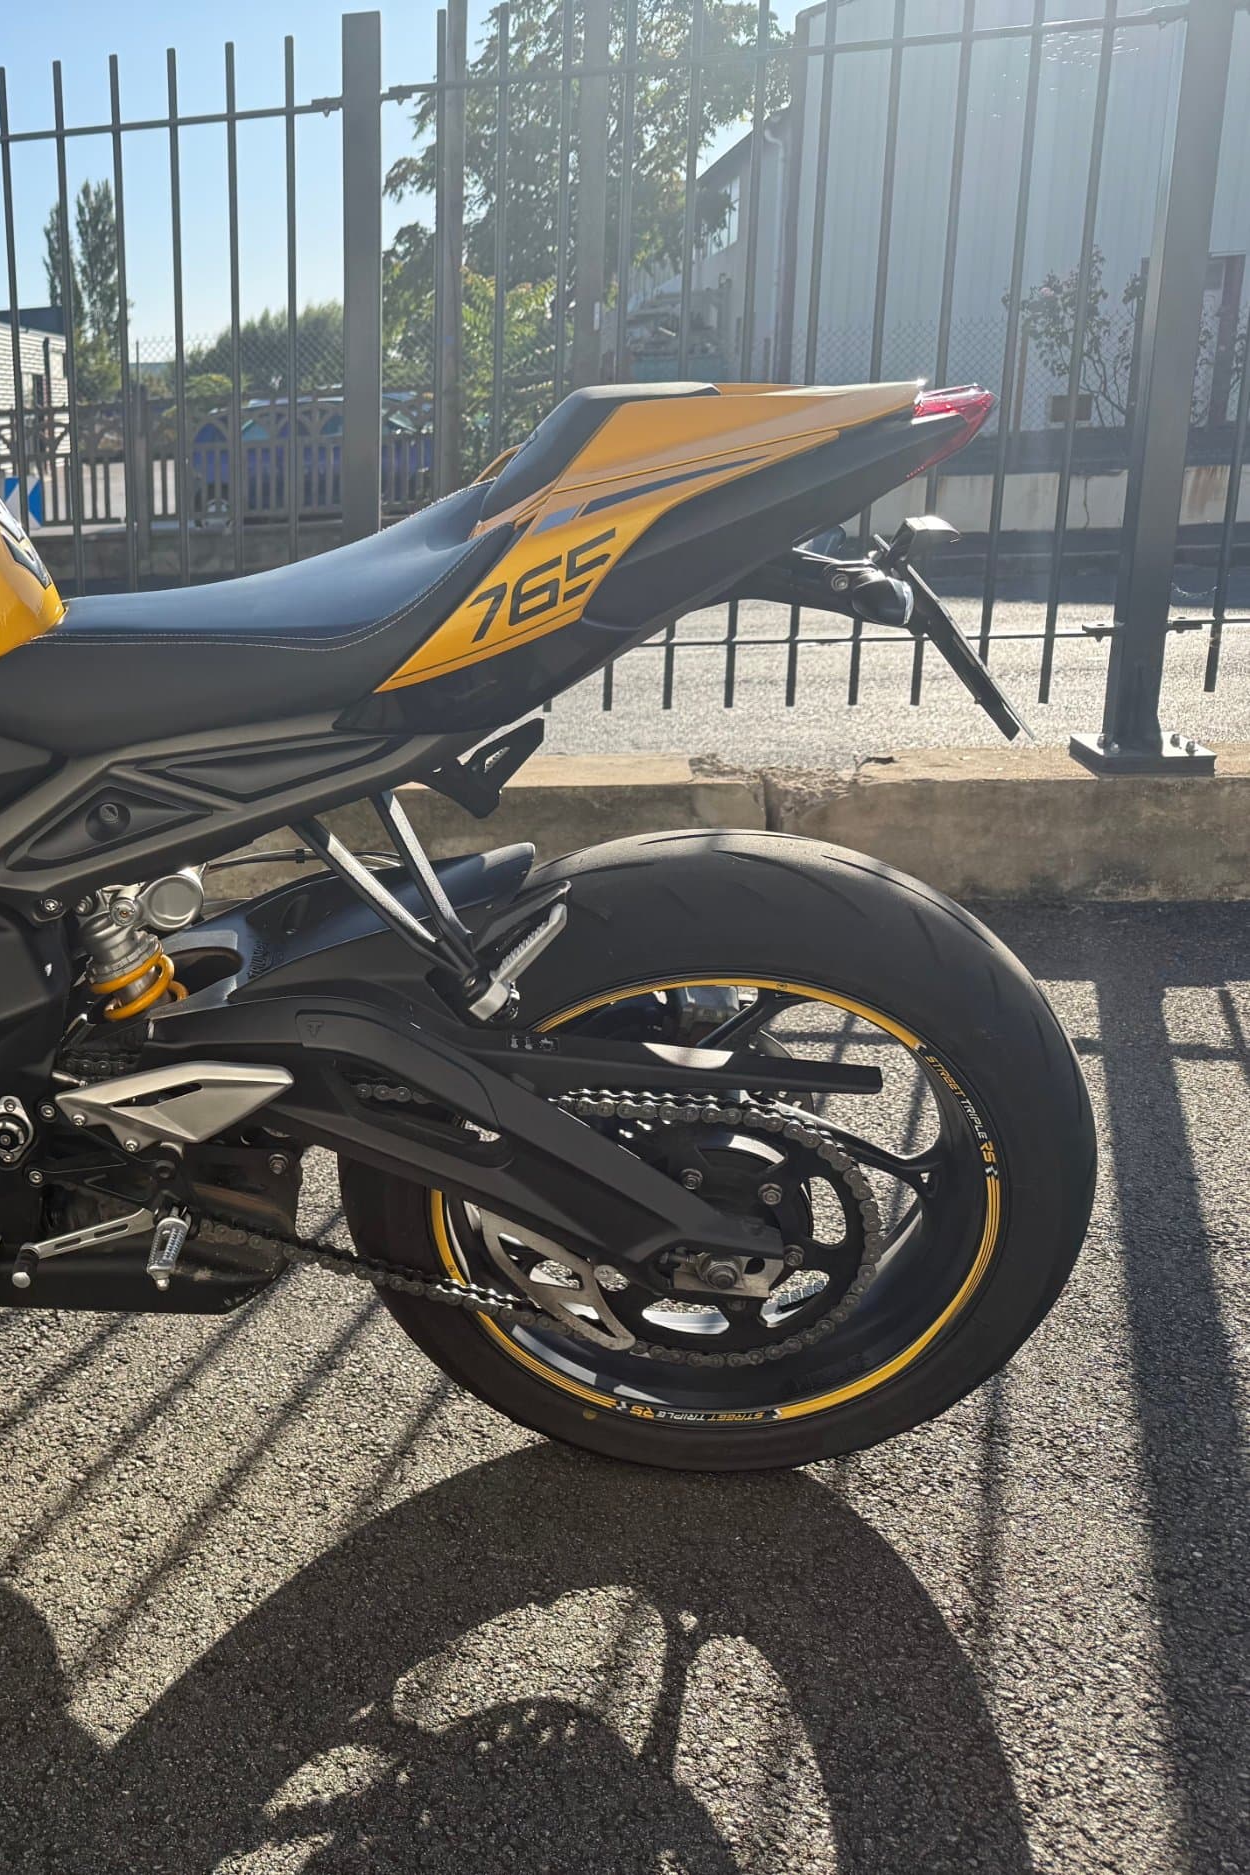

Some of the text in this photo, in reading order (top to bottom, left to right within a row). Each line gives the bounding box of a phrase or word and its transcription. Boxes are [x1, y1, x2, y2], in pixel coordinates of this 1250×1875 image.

[467, 527, 617, 643] 765
[925, 1055, 998, 1164] STREET TRIPLE RS
[629, 1404, 766, 1422] STREET TRIPLE RS
